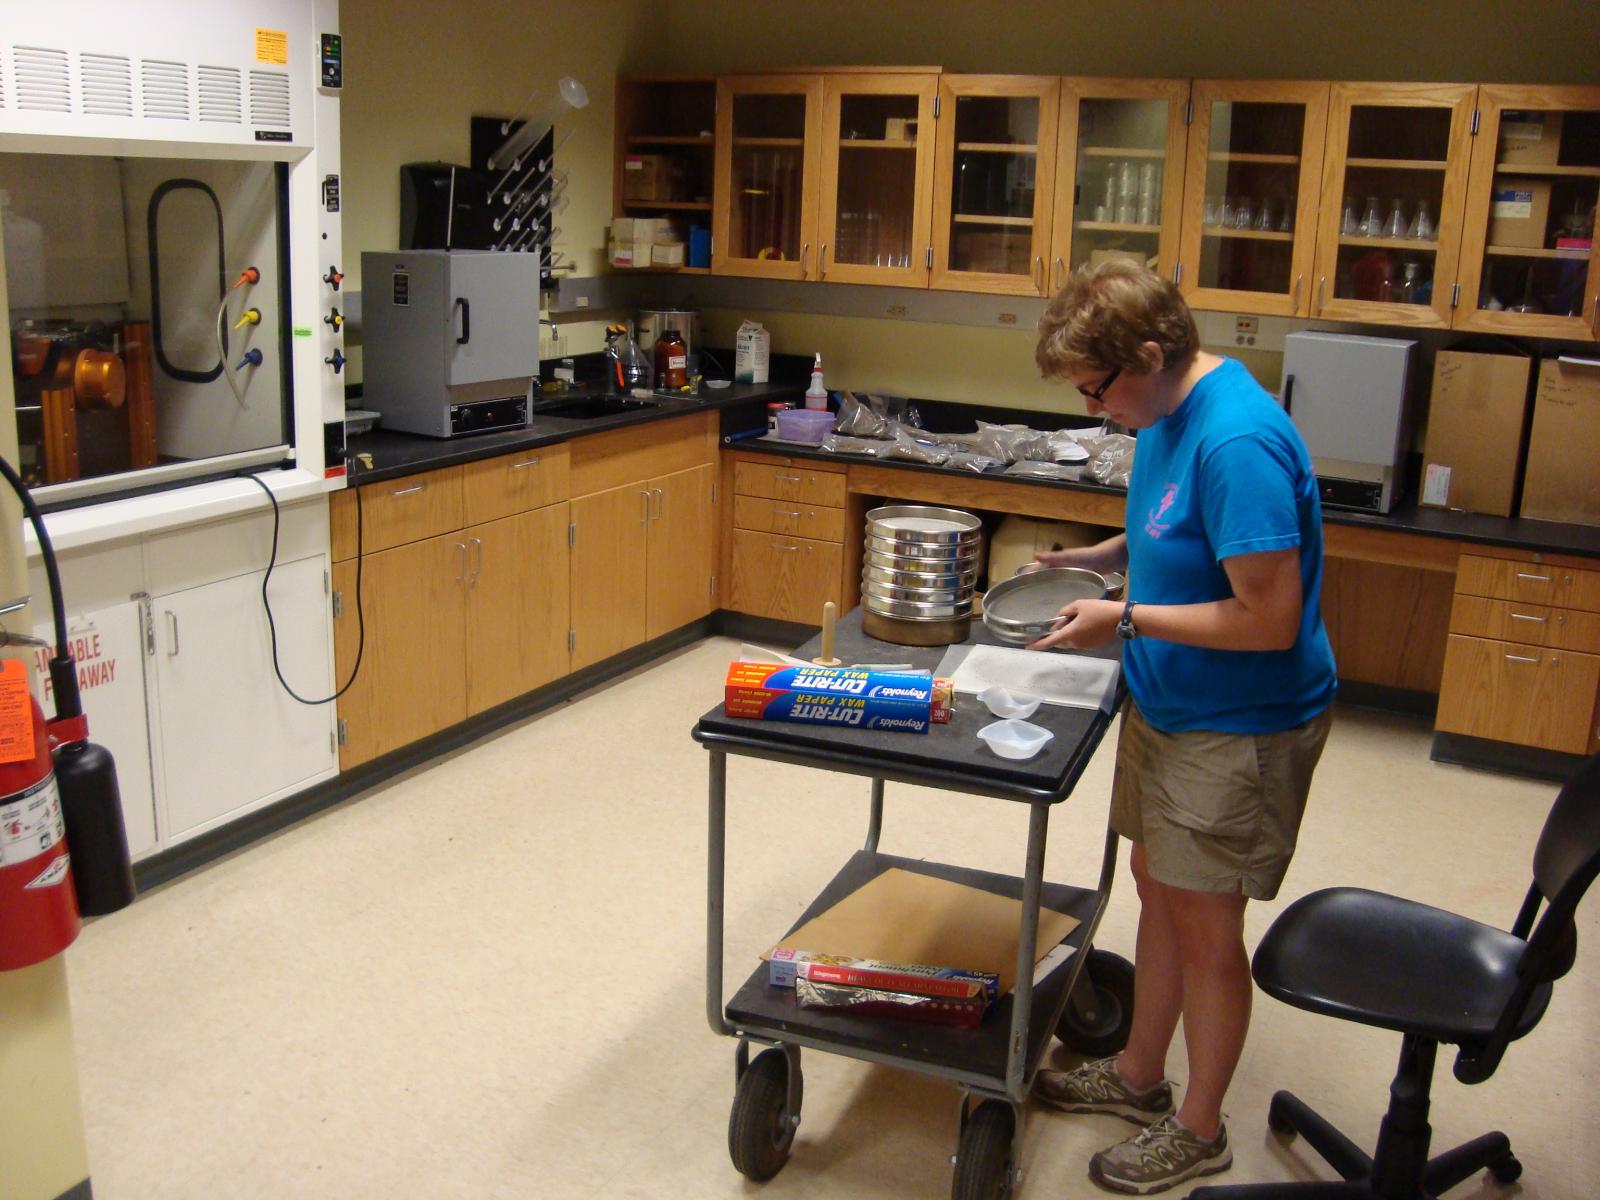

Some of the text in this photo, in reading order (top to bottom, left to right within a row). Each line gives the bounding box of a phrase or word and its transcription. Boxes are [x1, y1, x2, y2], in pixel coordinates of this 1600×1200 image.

[79, 658, 116, 691] AWAY
[800, 667, 840, 677] PAPER
[842, 671, 870, 679] WAX
[791, 674, 867, 694] CUT-RITE
[796, 694, 836, 705] PAPER
[882, 687, 927, 700] Reynolds
[839, 697, 866, 708] WAX
[789, 703, 864, 725] CUT-RITE
[880, 718, 926, 731] Reynolds
